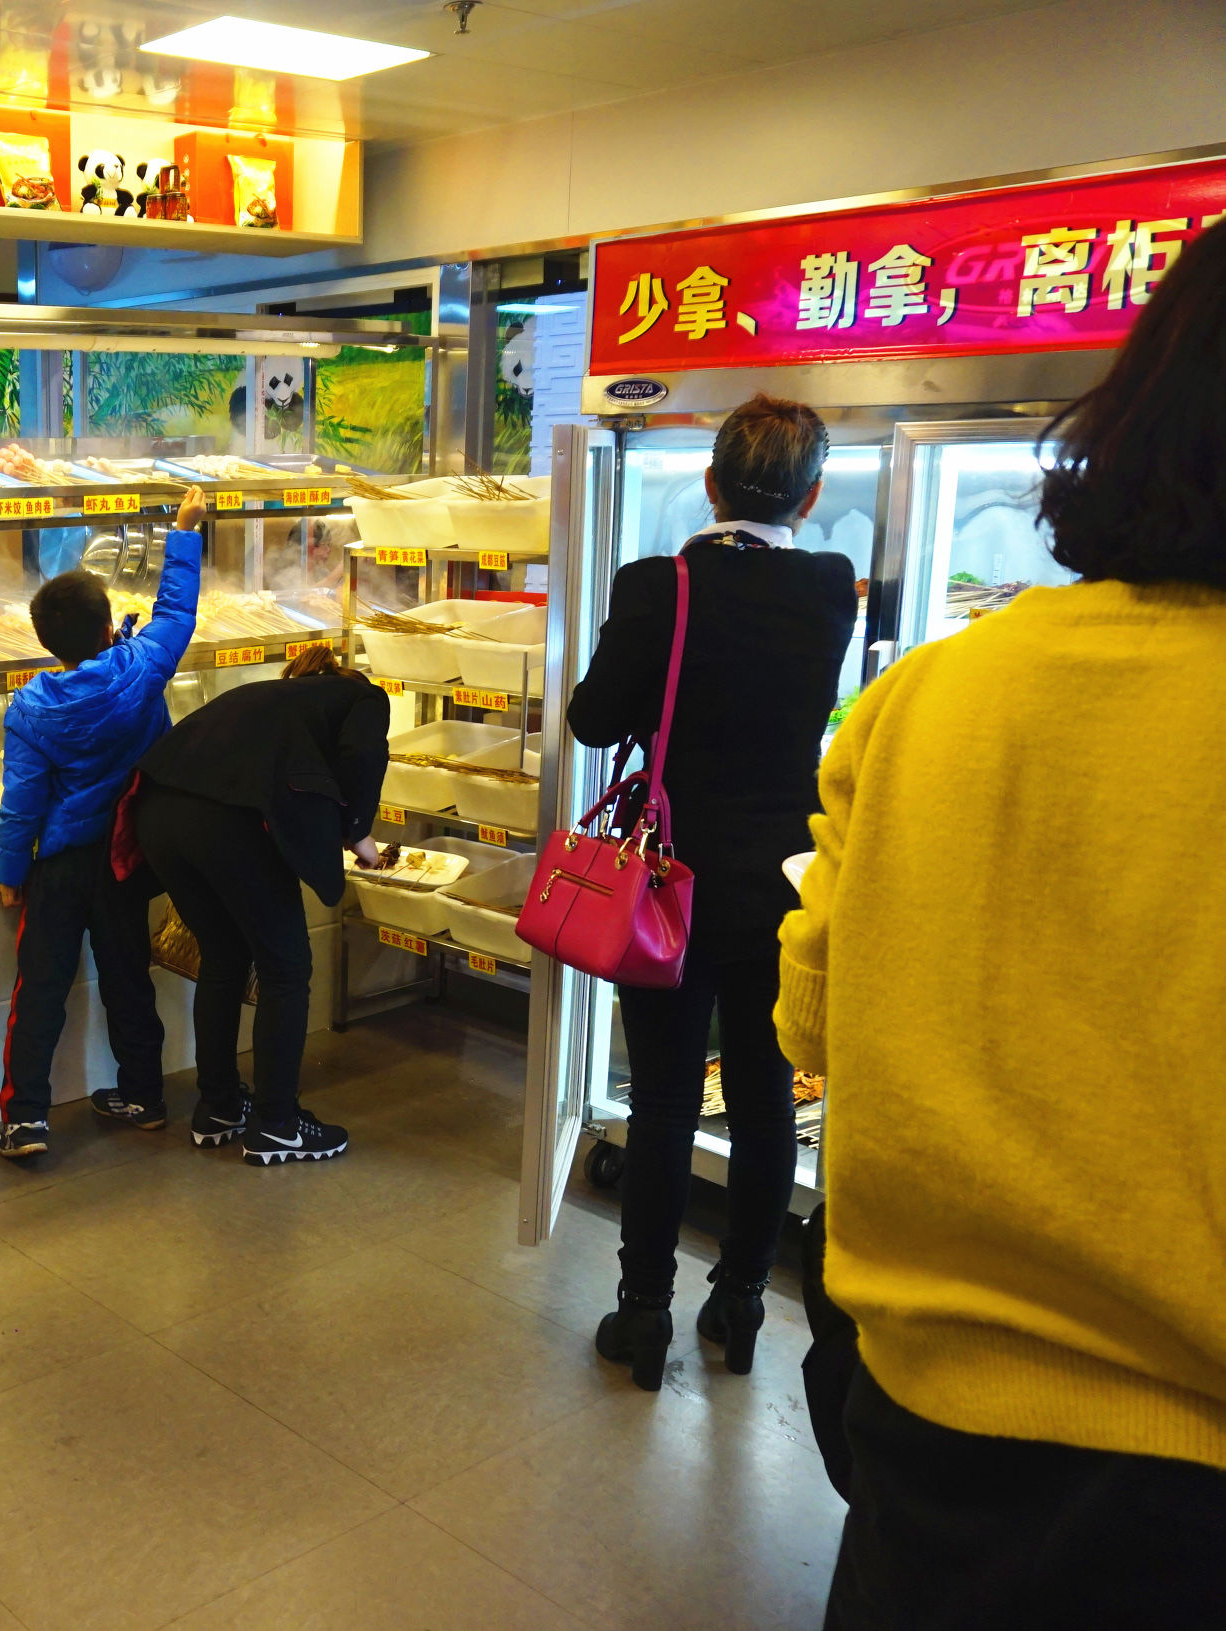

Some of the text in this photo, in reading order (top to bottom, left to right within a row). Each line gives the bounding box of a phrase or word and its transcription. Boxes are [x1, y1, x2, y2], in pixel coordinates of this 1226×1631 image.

[614, 383, 654, 394] GRISTA
[218, 493, 241, 508] 牛肉丸
[482, 694, 506, 709] 山药
[383, 808, 404, 823] 土豆
